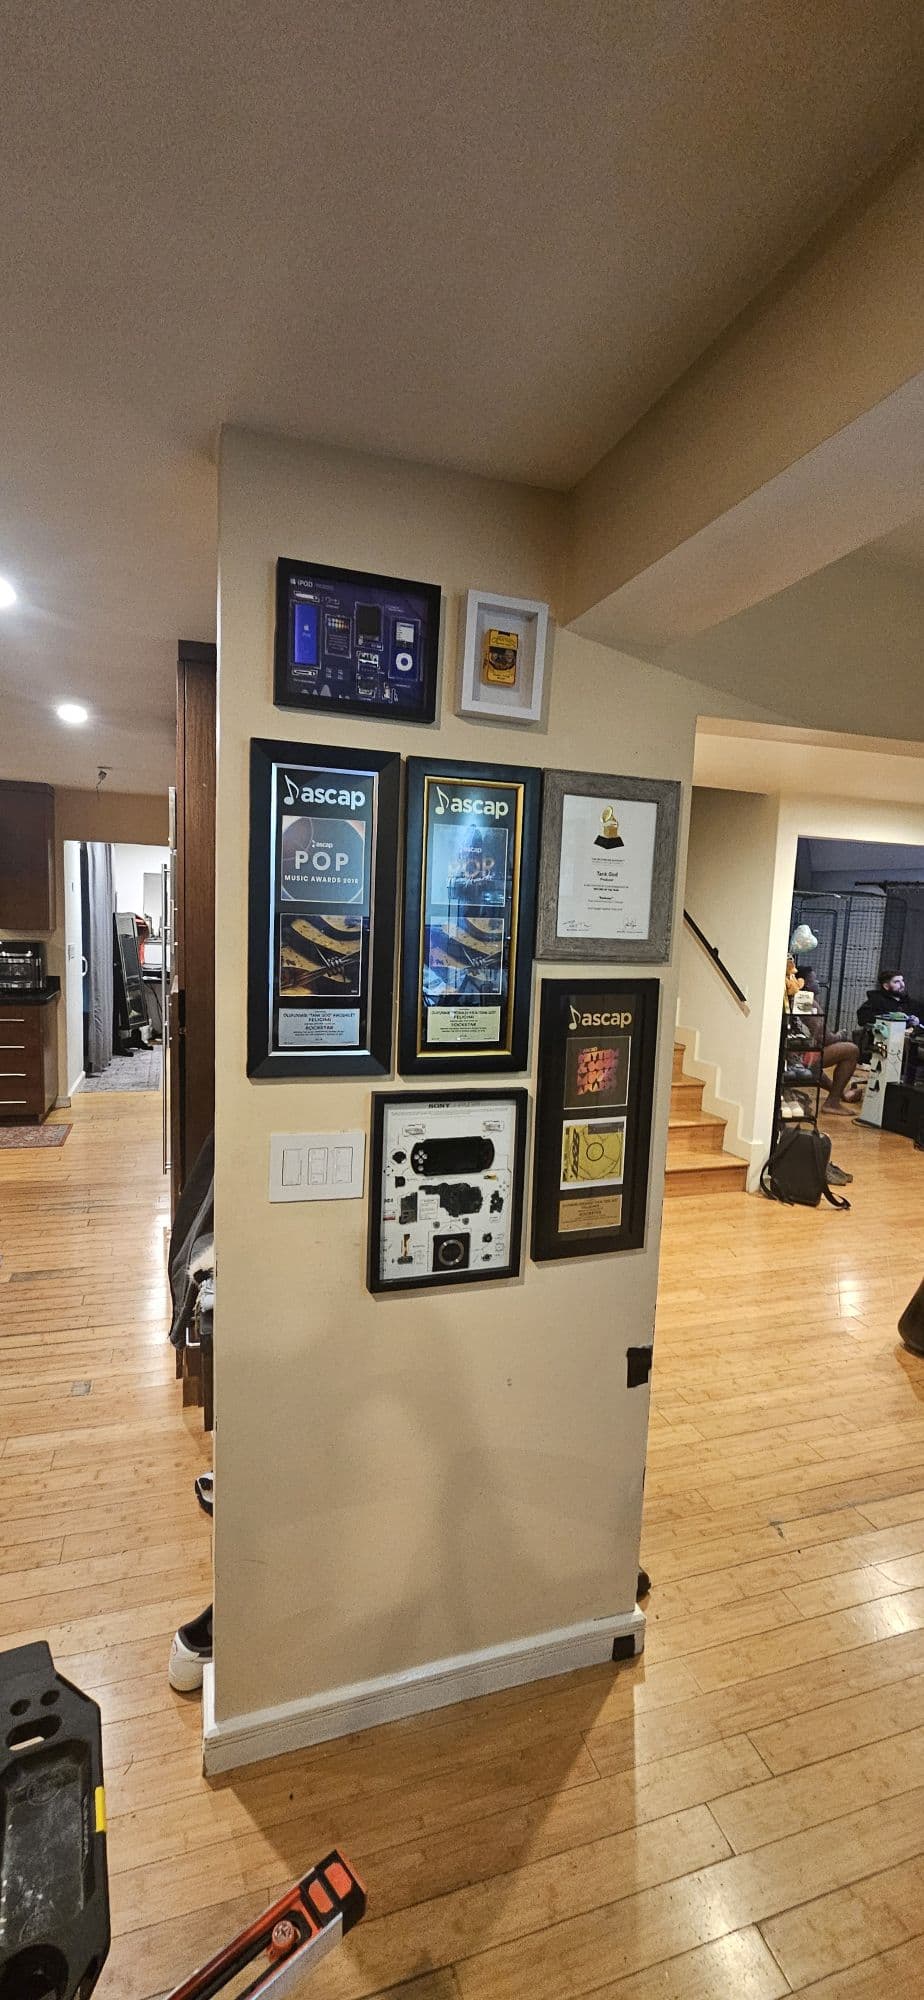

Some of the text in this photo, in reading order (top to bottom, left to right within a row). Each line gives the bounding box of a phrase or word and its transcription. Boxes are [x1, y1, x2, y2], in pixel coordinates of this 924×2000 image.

[301, 787, 366, 811] ascap
[450, 797, 509, 820] ascap
[294, 850, 350, 872] POP
[284, 874, 309, 882] MUSIC
[311, 876, 342, 884] AWARDS
[581, 1011, 632, 1029] ascap
